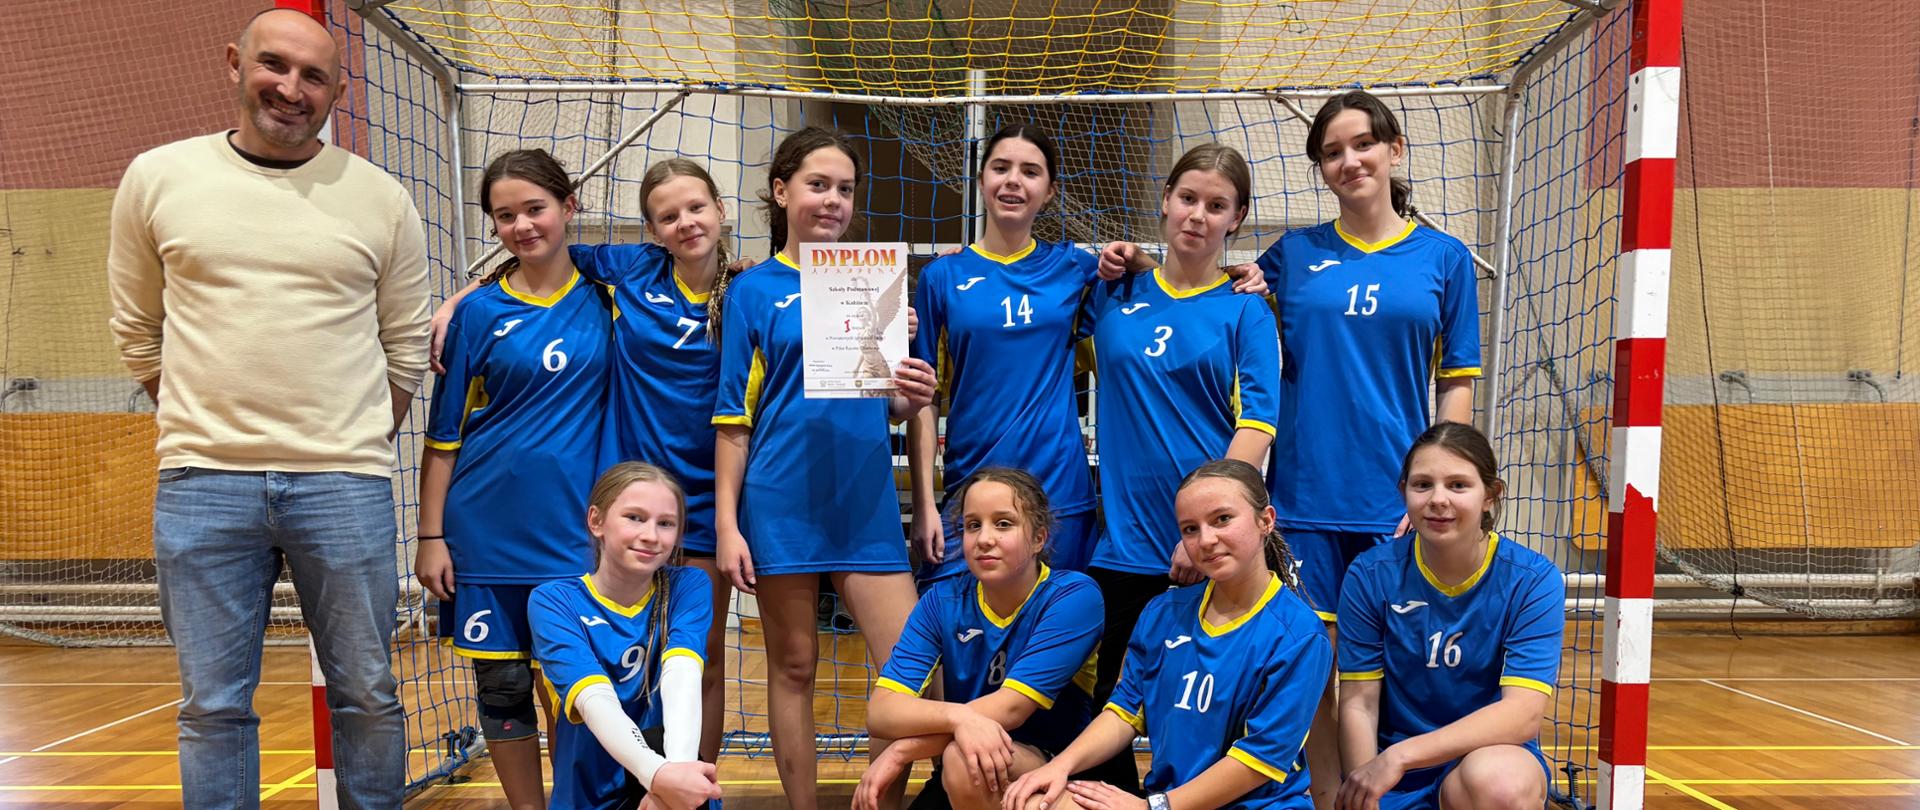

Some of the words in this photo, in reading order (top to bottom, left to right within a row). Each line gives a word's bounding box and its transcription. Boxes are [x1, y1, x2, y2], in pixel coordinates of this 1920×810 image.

[811, 248, 897, 267] DYPLOM
[1002, 295, 1033, 327] 14
[1345, 284, 1379, 315] 15
[672, 316, 701, 350] 7
[1144, 325, 1172, 357] 3
[542, 338, 568, 373] 6
[463, 609, 492, 643] 6
[619, 645, 646, 683] 9
[1427, 631, 1463, 668] 16
[987, 650, 1006, 686] 8
[1175, 671, 1215, 713] 10
